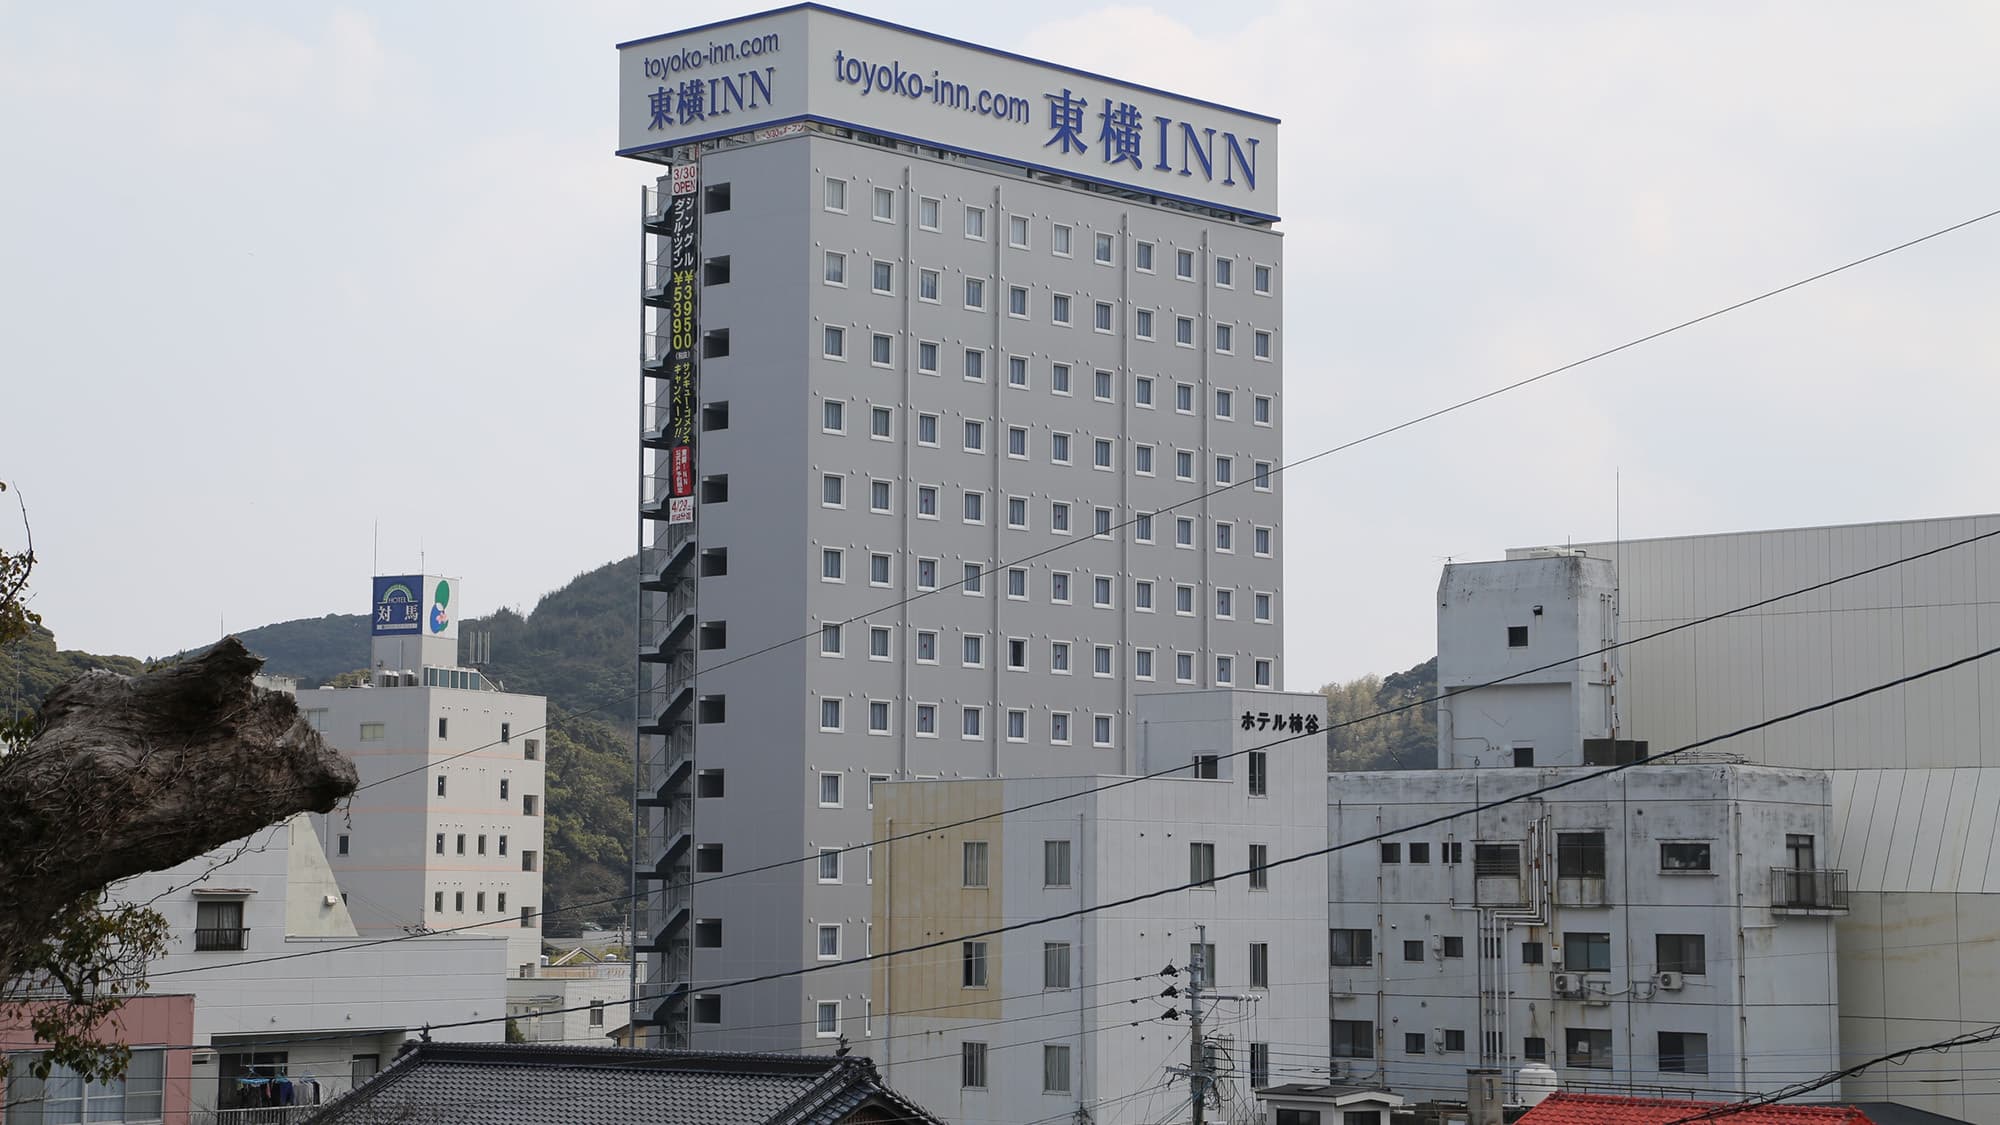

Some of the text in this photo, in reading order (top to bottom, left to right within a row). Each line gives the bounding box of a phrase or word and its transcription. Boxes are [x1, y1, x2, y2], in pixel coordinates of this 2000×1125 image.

[644, 33, 779, 80] toyoko-inn.com
[648, 67, 775, 130] 東横INN
[835, 50, 1030, 124] toyoko-inn.com
[1043, 88, 1259, 191] 東横INN
[673, 166, 695, 180] 3/30
[673, 180, 695, 193] OPEN
[684, 197, 695, 267] シングル
[377, 604, 418, 622] 対馬
[1241, 711, 1319, 735] ホテル柿谷
